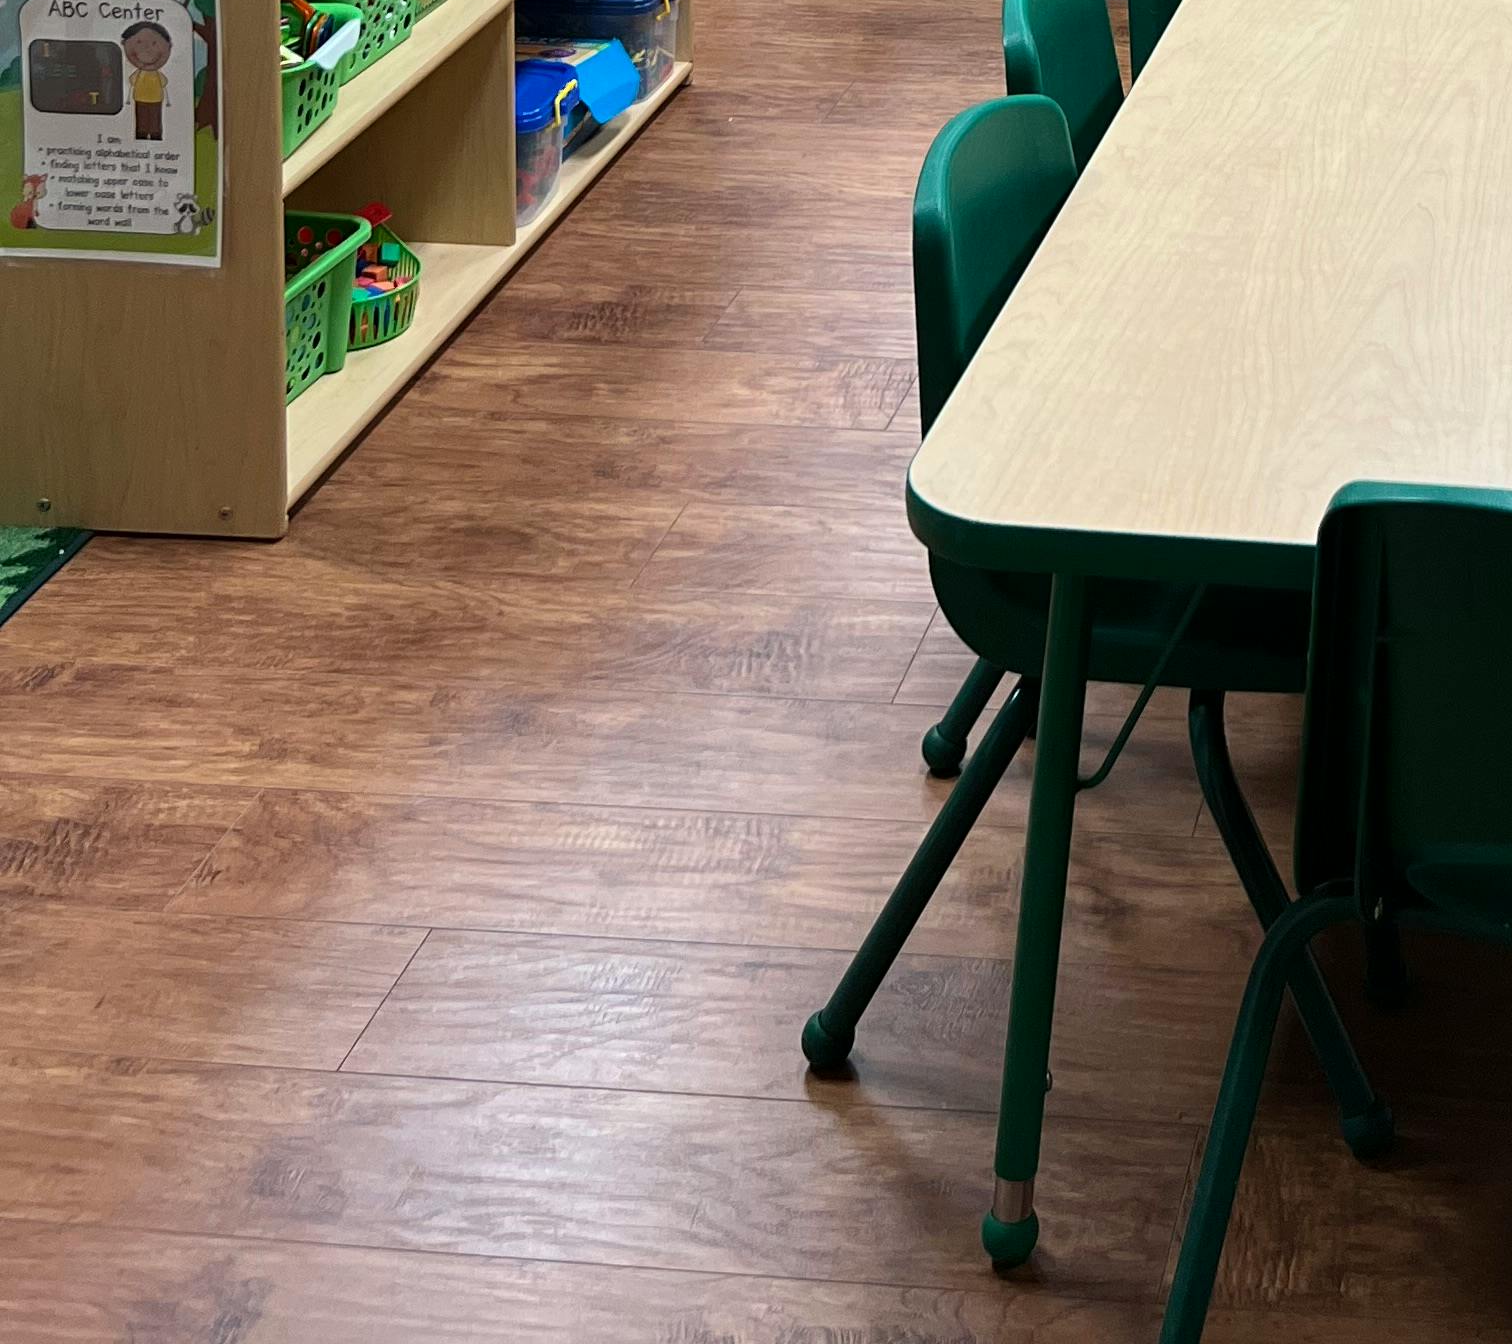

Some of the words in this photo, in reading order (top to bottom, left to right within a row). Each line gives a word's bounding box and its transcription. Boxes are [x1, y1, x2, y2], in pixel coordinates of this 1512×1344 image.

[48, 0, 89, 18] ABC
[98, 1, 165, 21] Center
[97, 133, 103, 144] I
[107, 136, 121, 144] am
[95, 148, 151, 159] alphabetical
[154, 151, 180, 161] order
[50, 159, 80, 173] finding
[83, 161, 117, 171] letters
[121, 162, 141, 173] that
[145, 163, 151, 173] I
[58, 174, 100, 188] matching
[103, 177, 129, 186] upper
[132, 178, 155, 187] case
[158, 177, 169, 188] to
[65, 187, 90, 198] lower
[95, 191, 116, 199] case
[121, 190, 154, 201] letters
[58, 201, 93, 215] forming
[96, 203, 123, 213] words
[128, 204, 150, 214] from
[154, 206, 169, 216] the
[87, 217, 111, 226] word
[114, 217, 132, 227] wall
